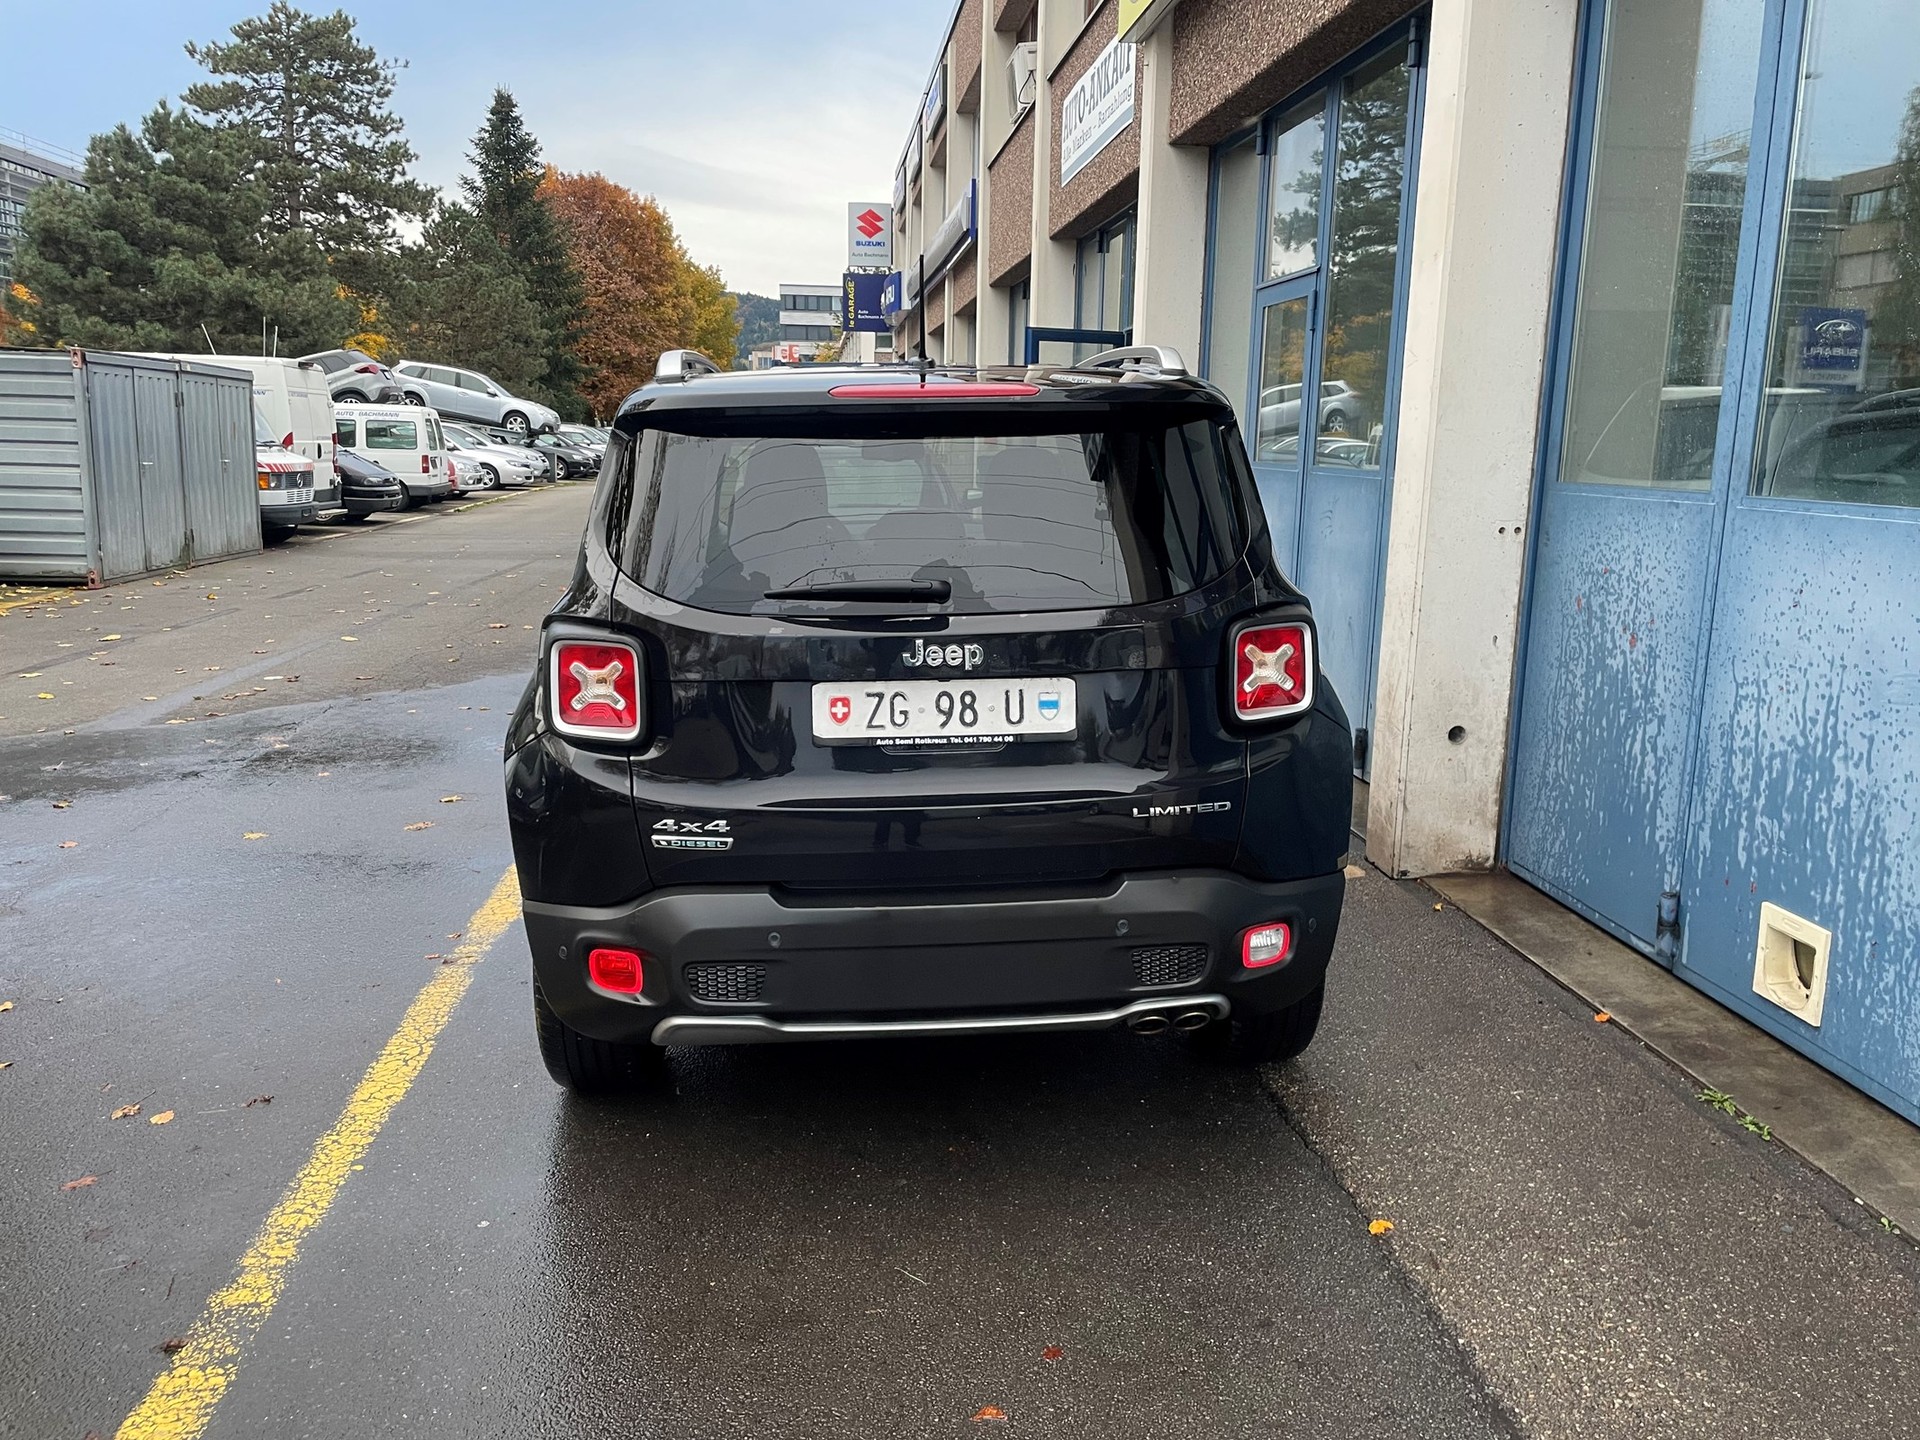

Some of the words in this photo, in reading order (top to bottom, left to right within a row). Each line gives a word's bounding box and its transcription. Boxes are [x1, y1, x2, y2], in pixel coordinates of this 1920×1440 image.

[1098, 83, 1133, 129] Barzahlung
[902, 639, 985, 671] Jeep
[865, 691, 910, 730] ZG
[934, 690, 979, 730] 98
[1004, 688, 1024, 726] U
[949, 736, 963, 744] Tel.
[1132, 801, 1232, 817] LIMITED
[652, 818, 731, 833] 4x4
[670, 840, 726, 848] DIESEL
